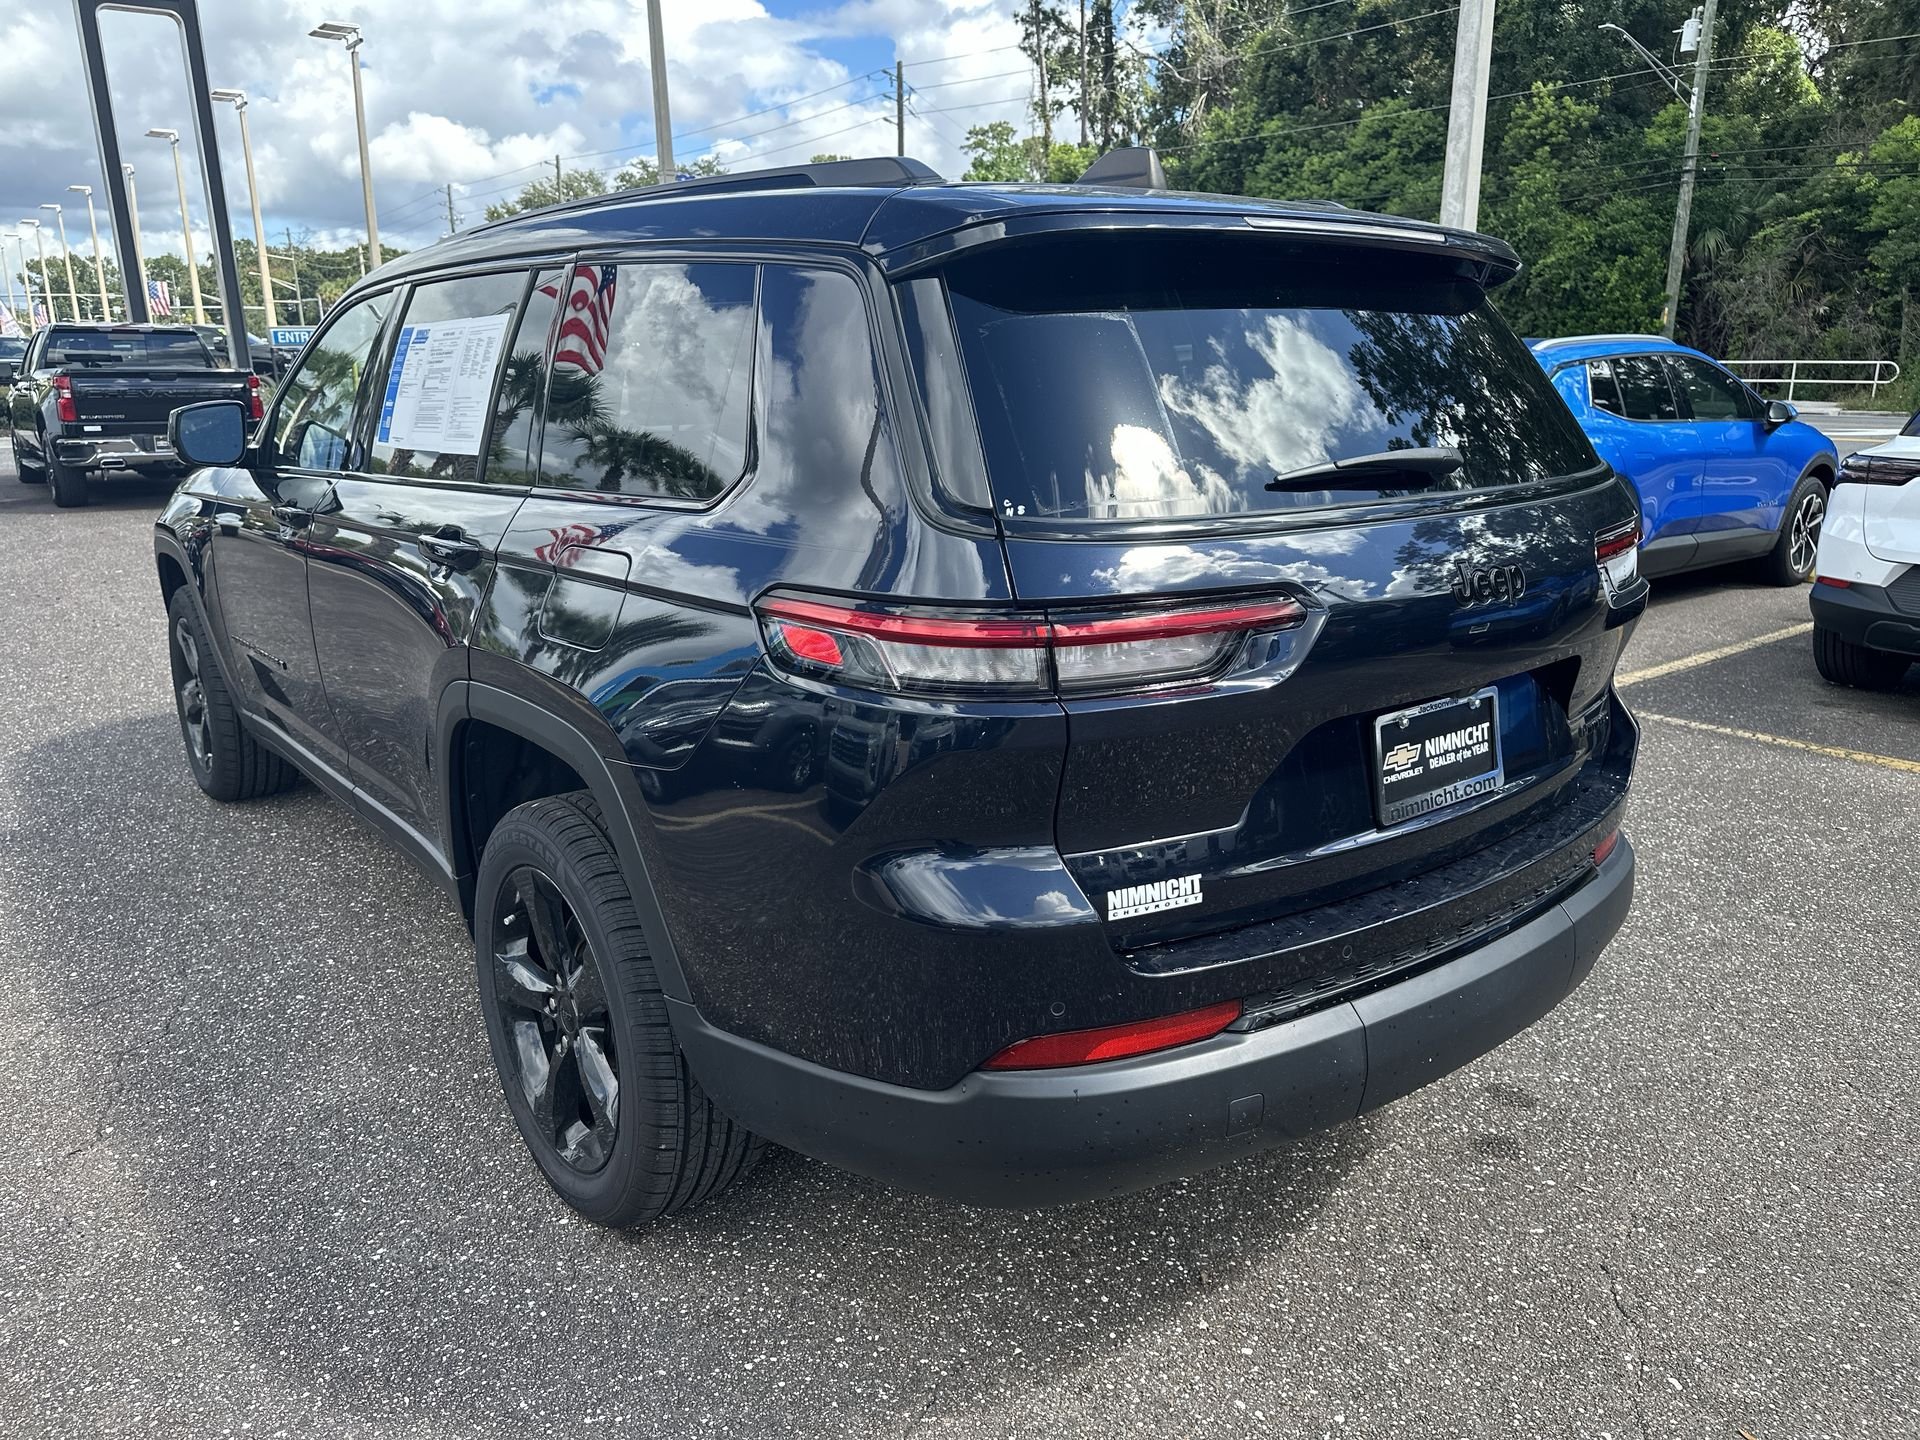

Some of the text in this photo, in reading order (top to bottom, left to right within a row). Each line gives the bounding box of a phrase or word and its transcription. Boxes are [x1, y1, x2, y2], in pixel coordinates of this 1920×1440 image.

[1451, 559, 1526, 608] Jeep
[1425, 721, 1490, 758] NIMNICHT
[1429, 741, 1489, 770] DEALER of the YEAR
[1383, 766, 1424, 784] CHEVROLET
[1390, 775, 1497, 822] nimnicht.com
[1107, 873, 1203, 911] NIMNICHT
[1112, 895, 1199, 918] CHEVROLET
